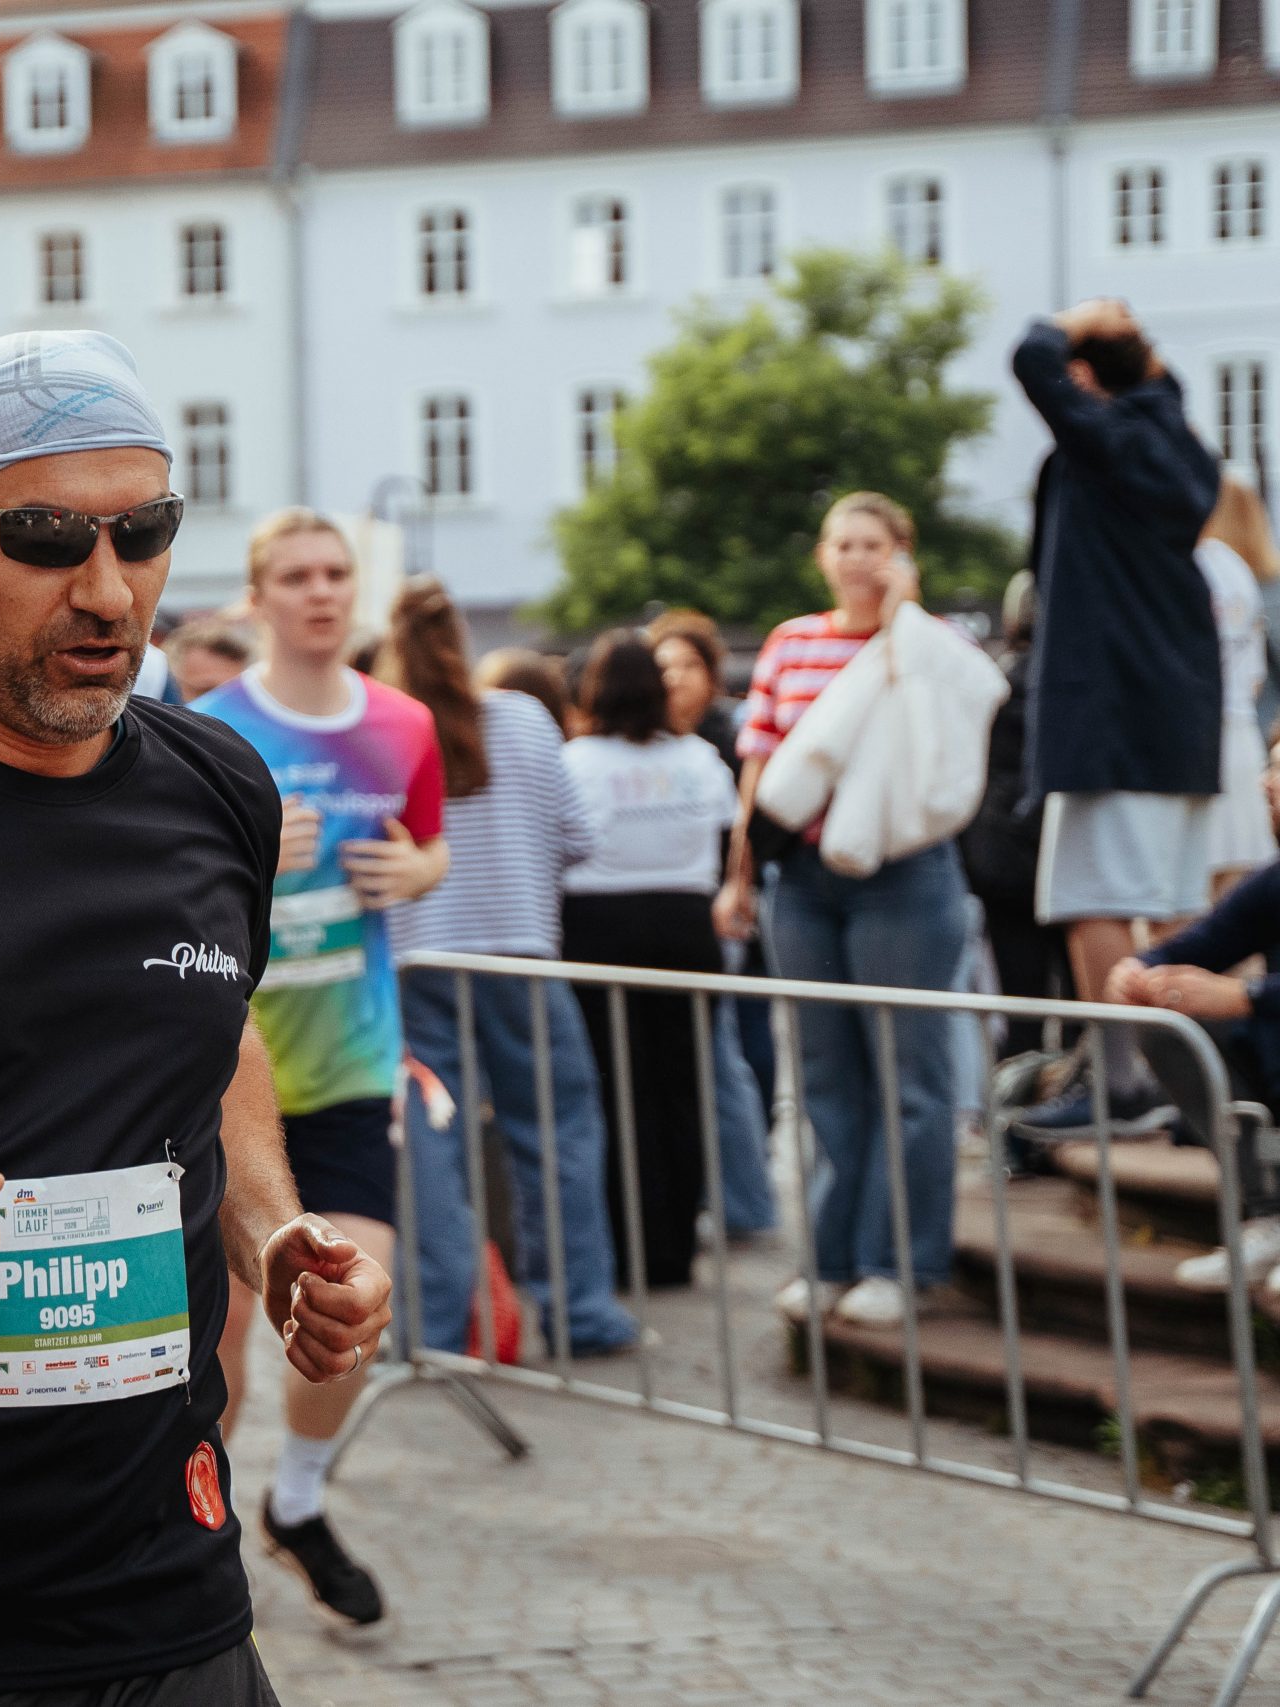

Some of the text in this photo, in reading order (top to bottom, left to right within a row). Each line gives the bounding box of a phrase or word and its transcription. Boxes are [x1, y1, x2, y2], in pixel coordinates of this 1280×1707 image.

[143, 942, 239, 981] Philipp
[17, 1189, 34, 1199] dm
[17, 1208, 48, 1219] FIRMEN
[18, 1219, 48, 1233] LAUF
[39, 1303, 96, 1330] 9095
[34, 1336, 69, 1348] STARTZEIT
[89, 1333, 102, 1344] UHR
